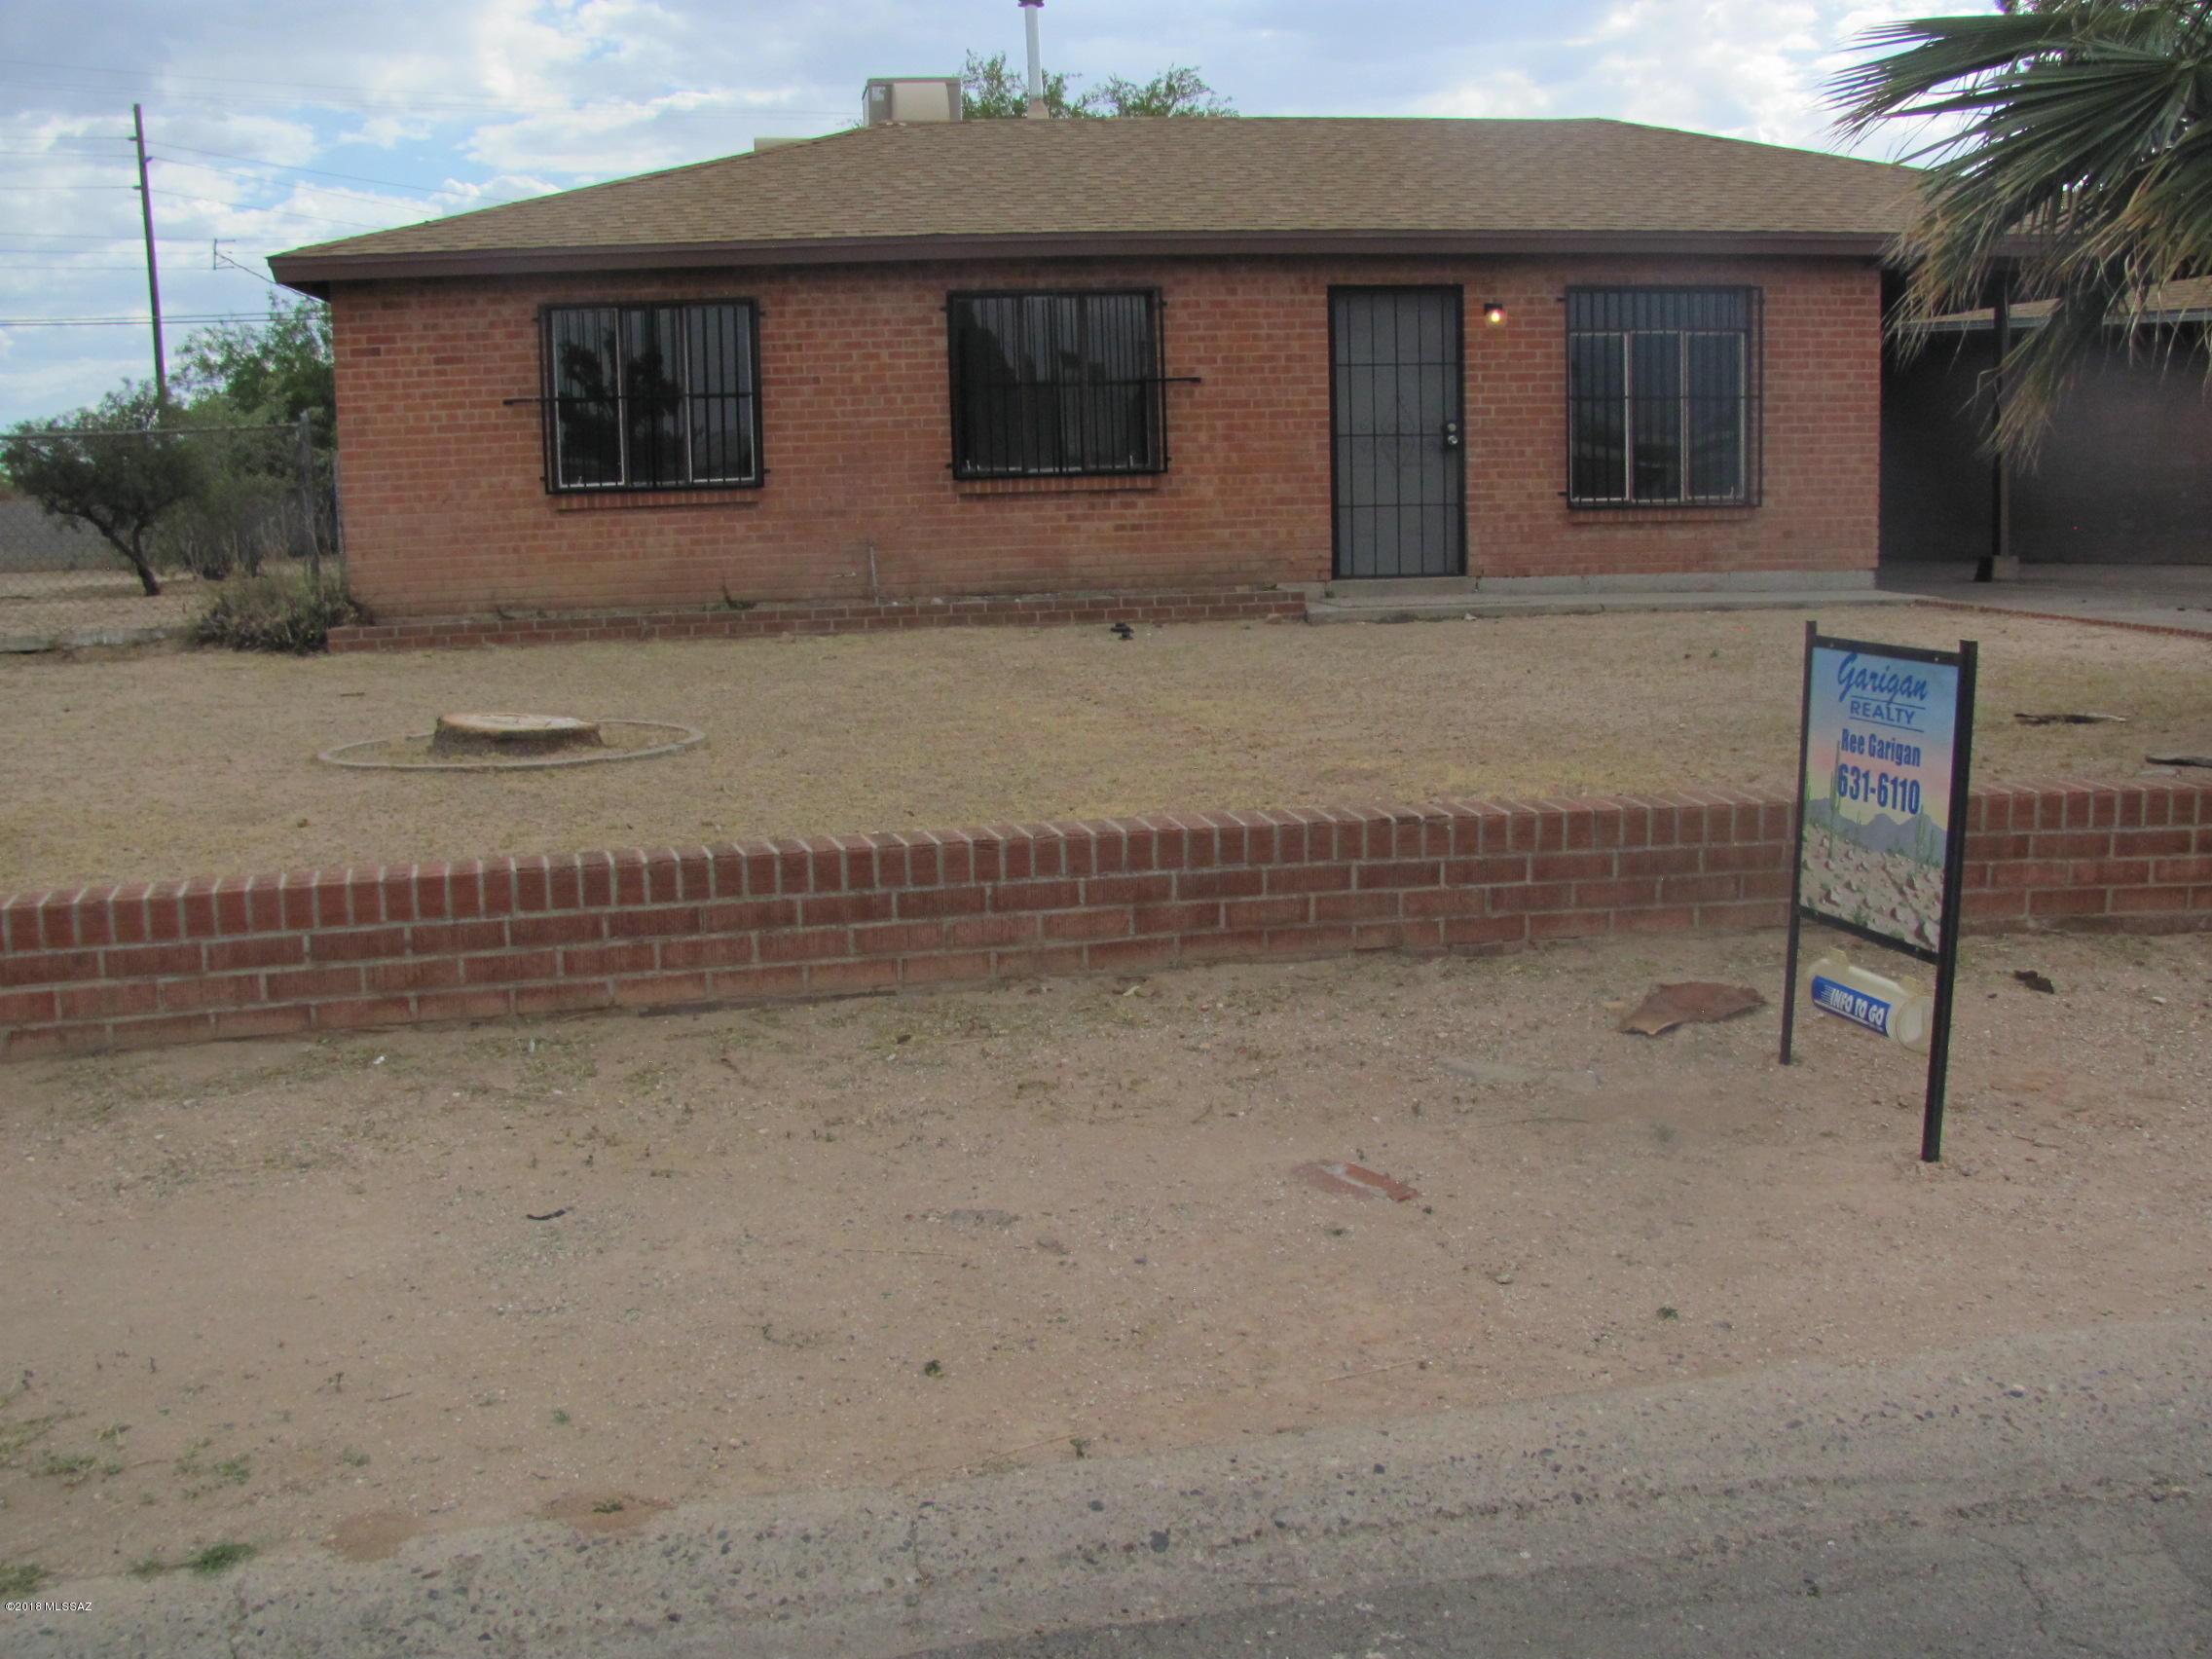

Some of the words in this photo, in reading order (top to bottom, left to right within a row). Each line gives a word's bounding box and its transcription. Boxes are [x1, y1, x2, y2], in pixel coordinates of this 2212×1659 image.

[1837, 651, 1929, 705] Garigan
[1851, 700, 1915, 724] REALTY
[1868, 733, 1921, 767] Garigan
[1837, 763, 1921, 815] 631-6110
[1829, 988, 1854, 1014] INFO
[1855, 998, 1868, 1019] TO
[1868, 1004, 1885, 1026] GO
